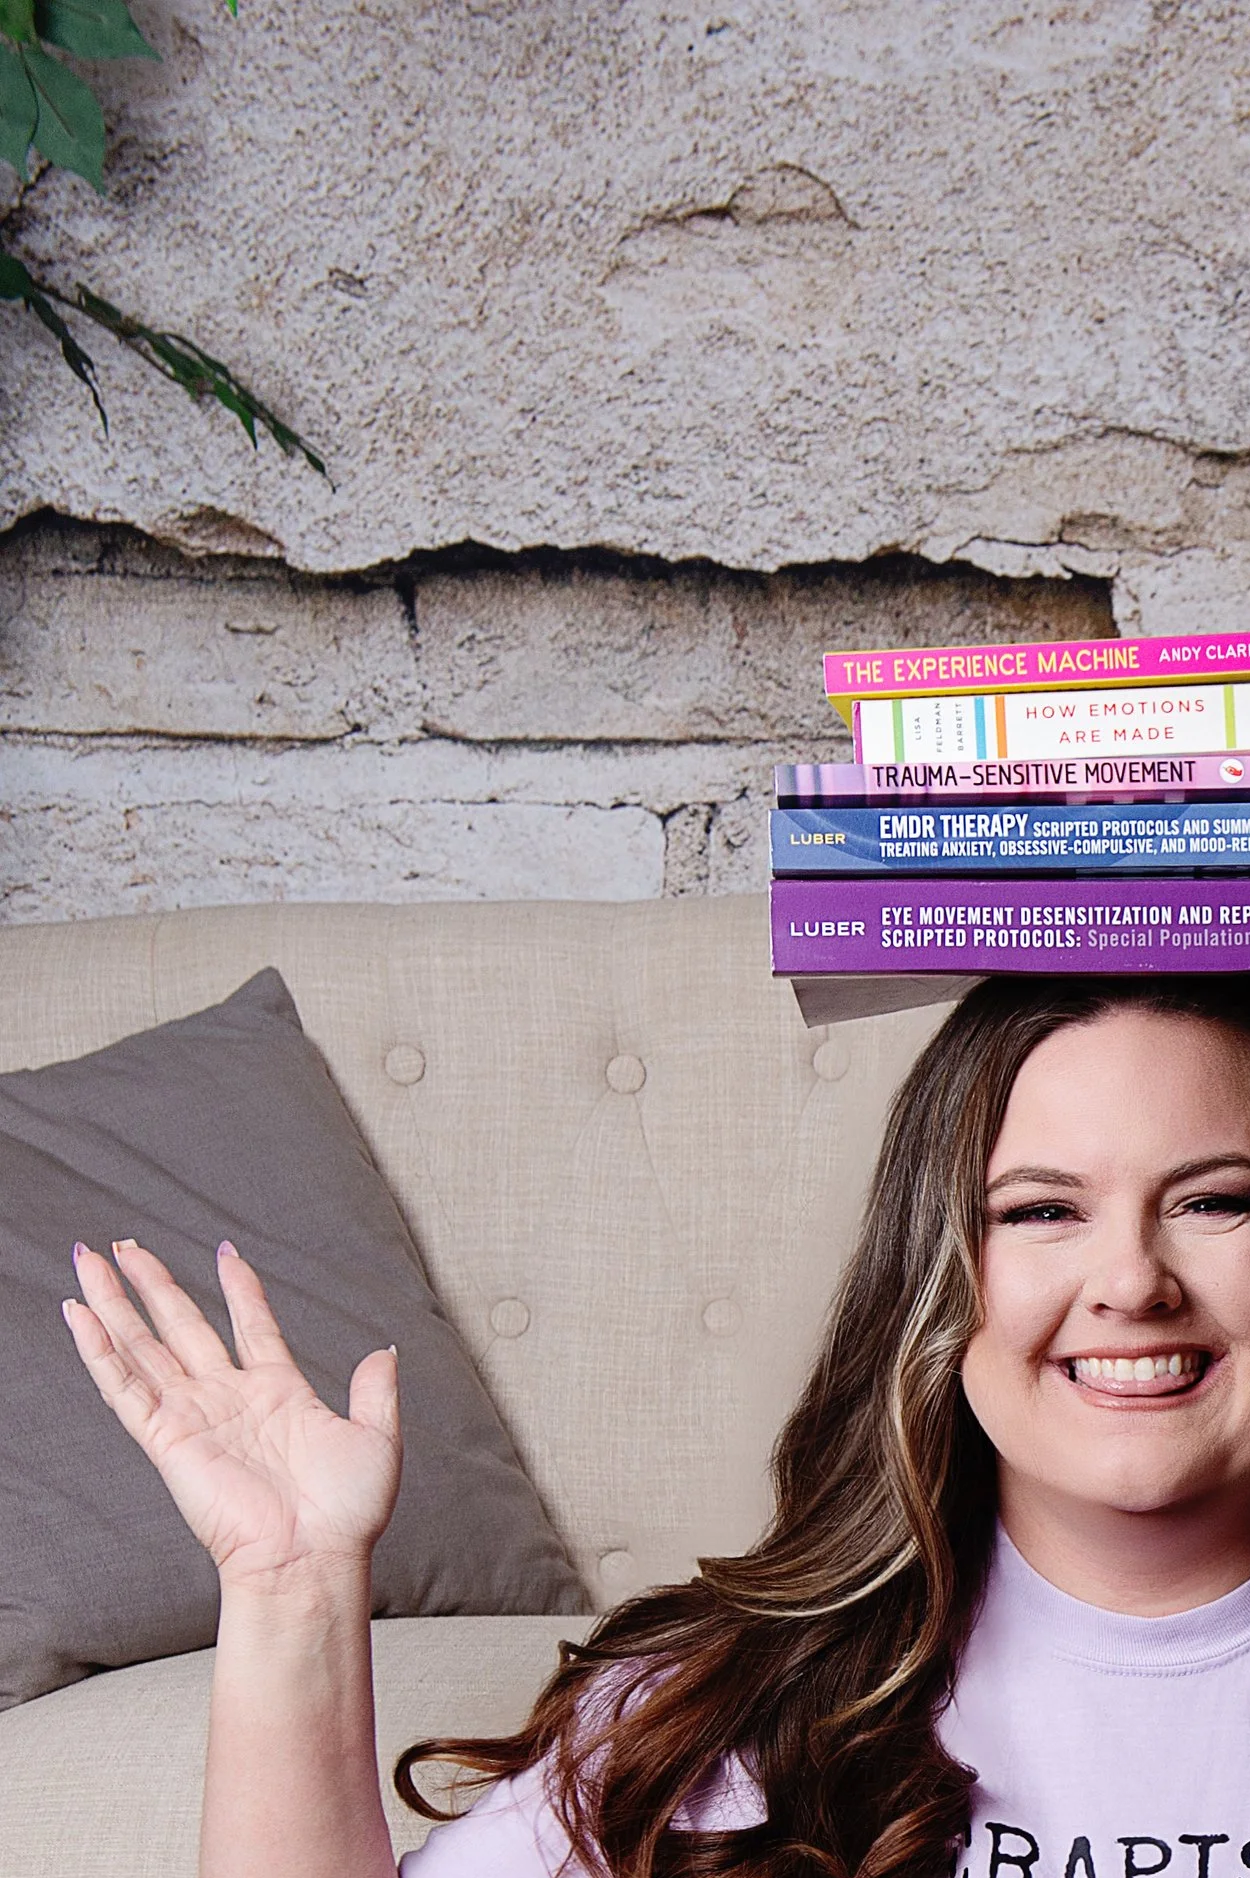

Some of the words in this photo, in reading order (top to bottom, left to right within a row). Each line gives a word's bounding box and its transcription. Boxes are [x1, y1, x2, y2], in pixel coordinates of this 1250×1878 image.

[1158, 644, 1202, 663] ANDY
[843, 660, 883, 685] THE
[893, 652, 1028, 683] EXPERIENCE
[1037, 646, 1140, 674] MACHINE
[1025, 704, 1077, 720] HOW
[1089, 699, 1206, 718] EMOTIONS
[914, 716, 922, 741] LISA
[934, 702, 943, 753] FELDMAN
[955, 702, 964, 752] BARRETT
[1059, 730, 1102, 744] ARE
[1113, 726, 1176, 742] MADE
[872, 762, 1077, 788] TRAUMA-SENSITIVE
[1085, 760, 1197, 784] MOVEMENT
[879, 815, 935, 839] EMDR
[939, 813, 1029, 838] THERAPY
[1032, 820, 1099, 838] SCRIPTED
[1102, 818, 1180, 837] PROTOCOLS
[1183, 818, 1211, 835] AND
[789, 832, 846, 846] LUBER
[879, 841, 940, 858] TREATING
[941, 840, 997, 858] ANXIETY,
[999, 837, 1158, 857] OBSESSIVE-COMPULSIVE,
[1160, 837, 1188, 854] AND
[880, 906, 914, 926] EYE
[918, 906, 1015, 926] MOVEMENT
[1020, 905, 1177, 926] DESENSITIZATION
[1178, 905, 1213, 925] AND
[789, 920, 866, 938] LUBER
[880, 928, 967, 948] SCRIPTED
[973, 928, 1082, 948] PROTOCOLS:
[1087, 928, 1153, 951] Special
